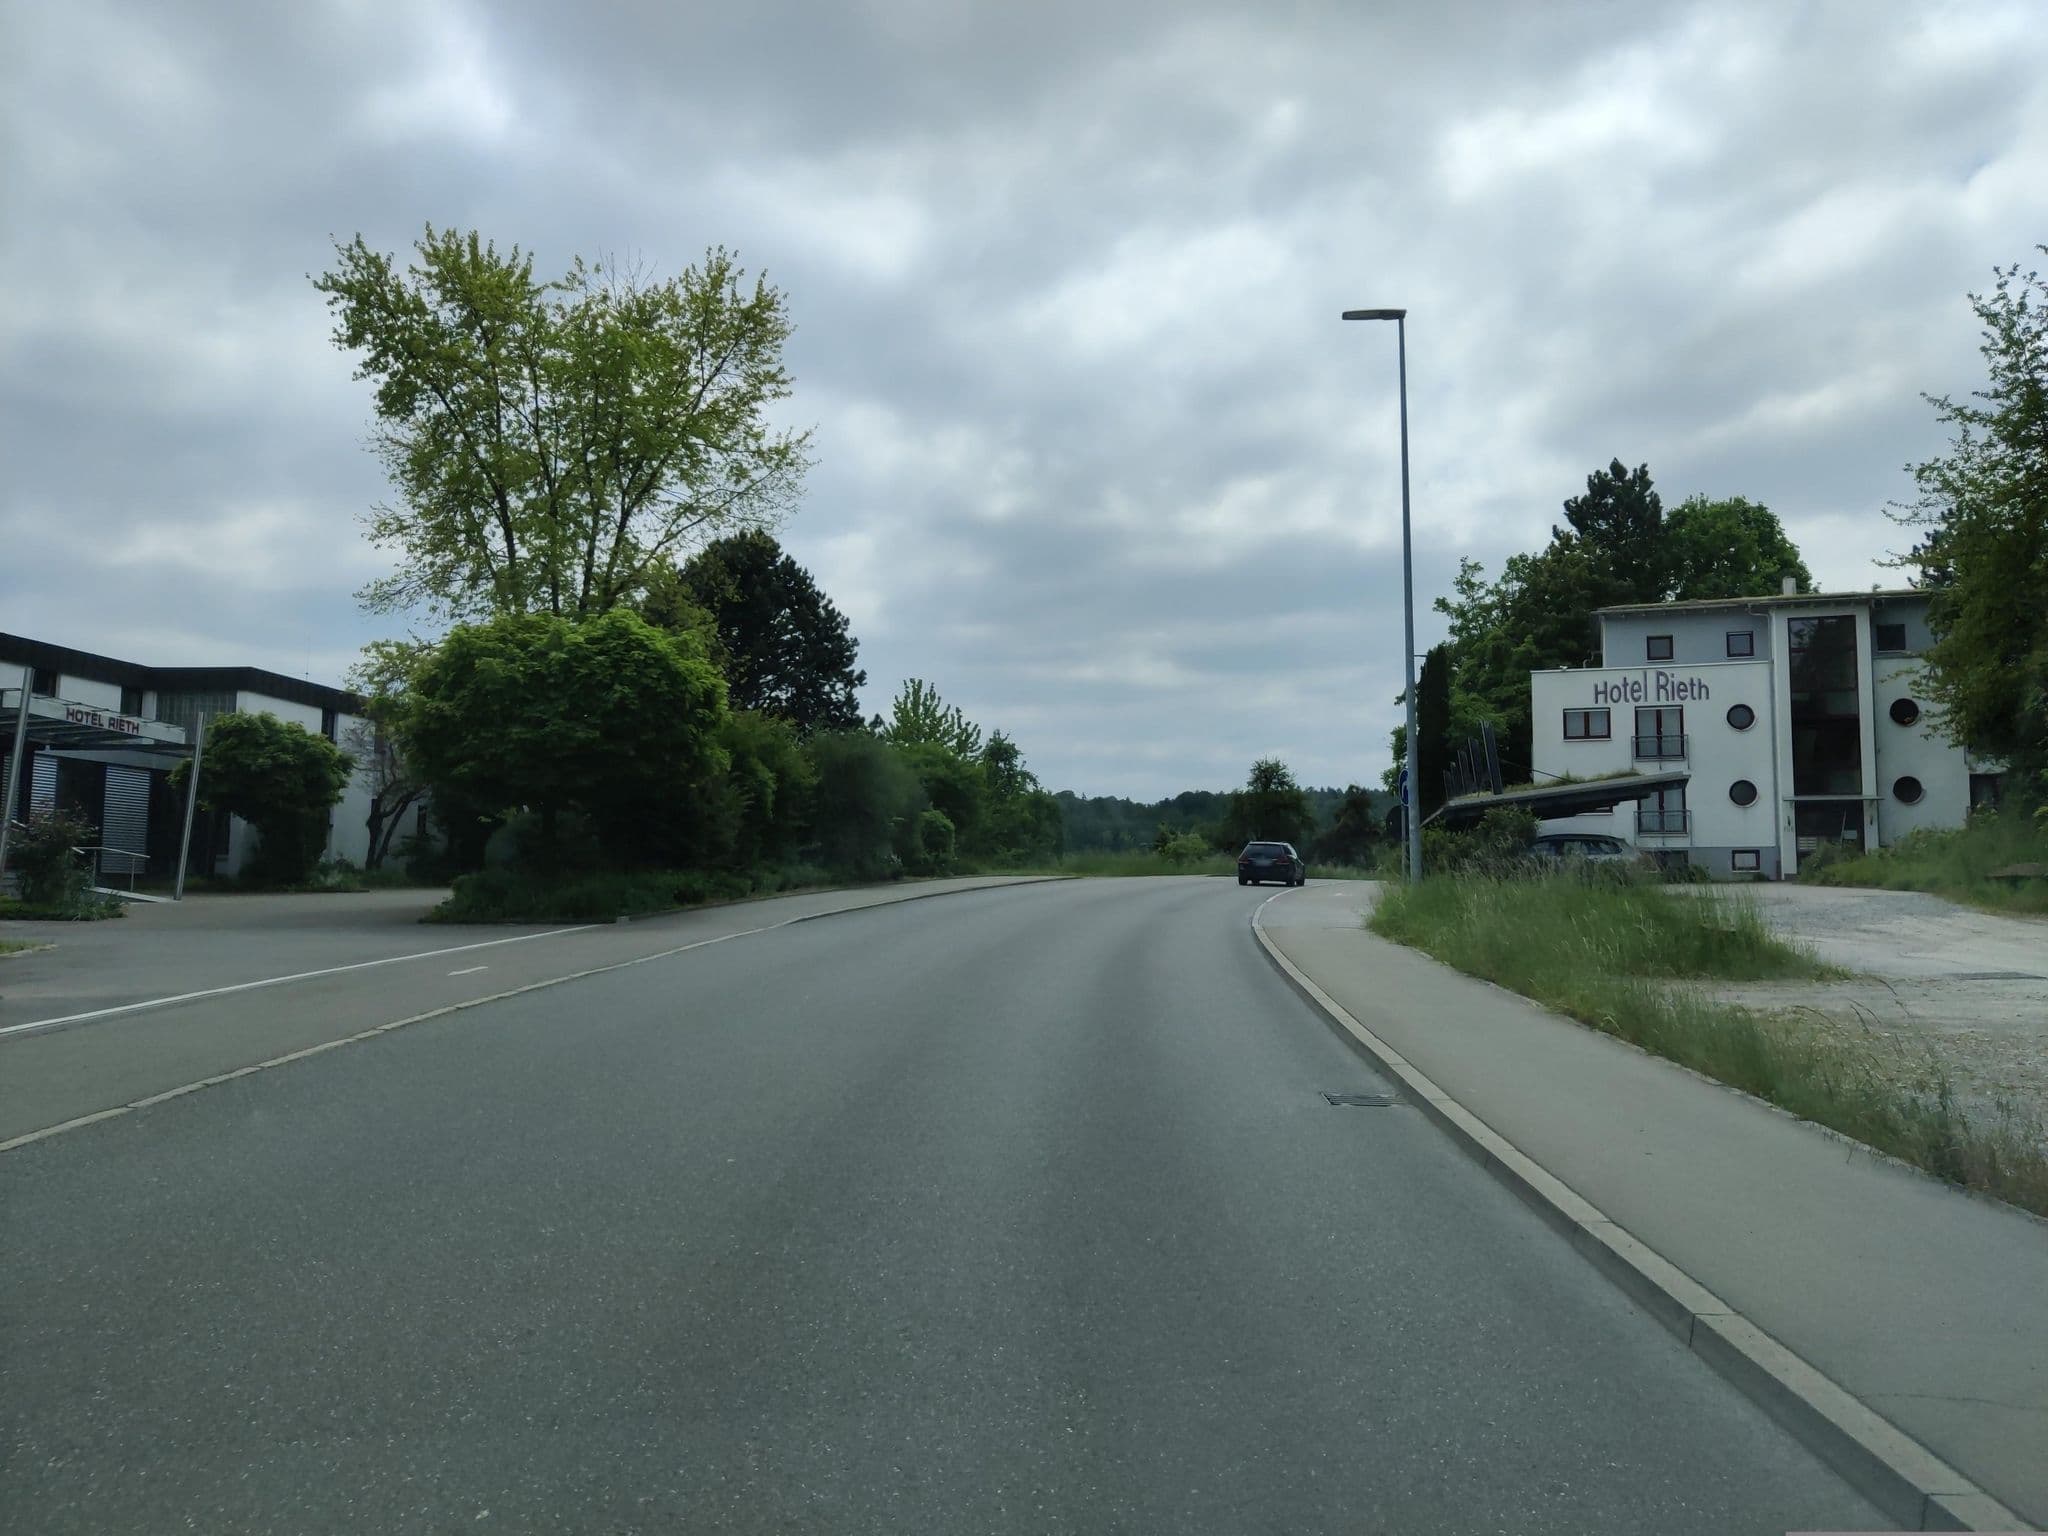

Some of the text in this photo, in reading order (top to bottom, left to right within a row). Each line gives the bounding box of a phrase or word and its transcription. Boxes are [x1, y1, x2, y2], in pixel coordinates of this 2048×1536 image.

[1594, 670, 1710, 704] Hotel Rieth
[66, 707, 139, 734] HOTEL RIETH
